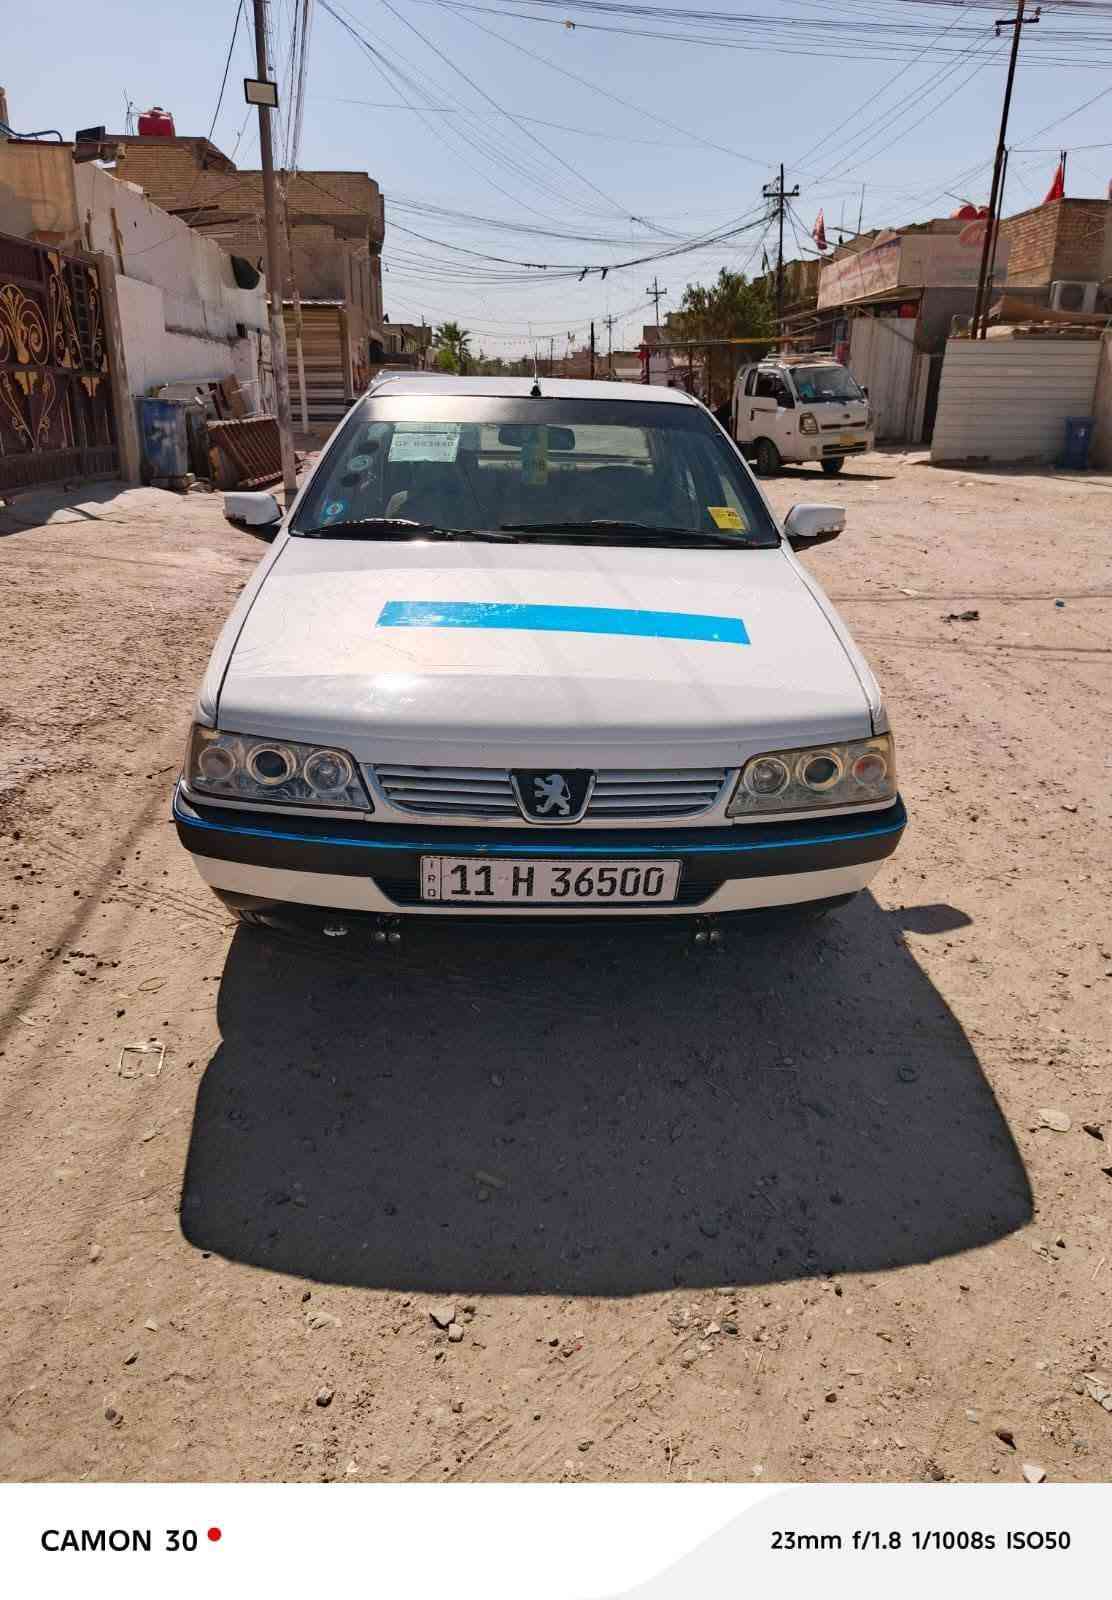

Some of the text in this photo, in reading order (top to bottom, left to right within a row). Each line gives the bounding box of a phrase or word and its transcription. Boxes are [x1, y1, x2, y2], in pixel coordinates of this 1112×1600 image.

[450, 864, 665, 897] 11 H 36500
